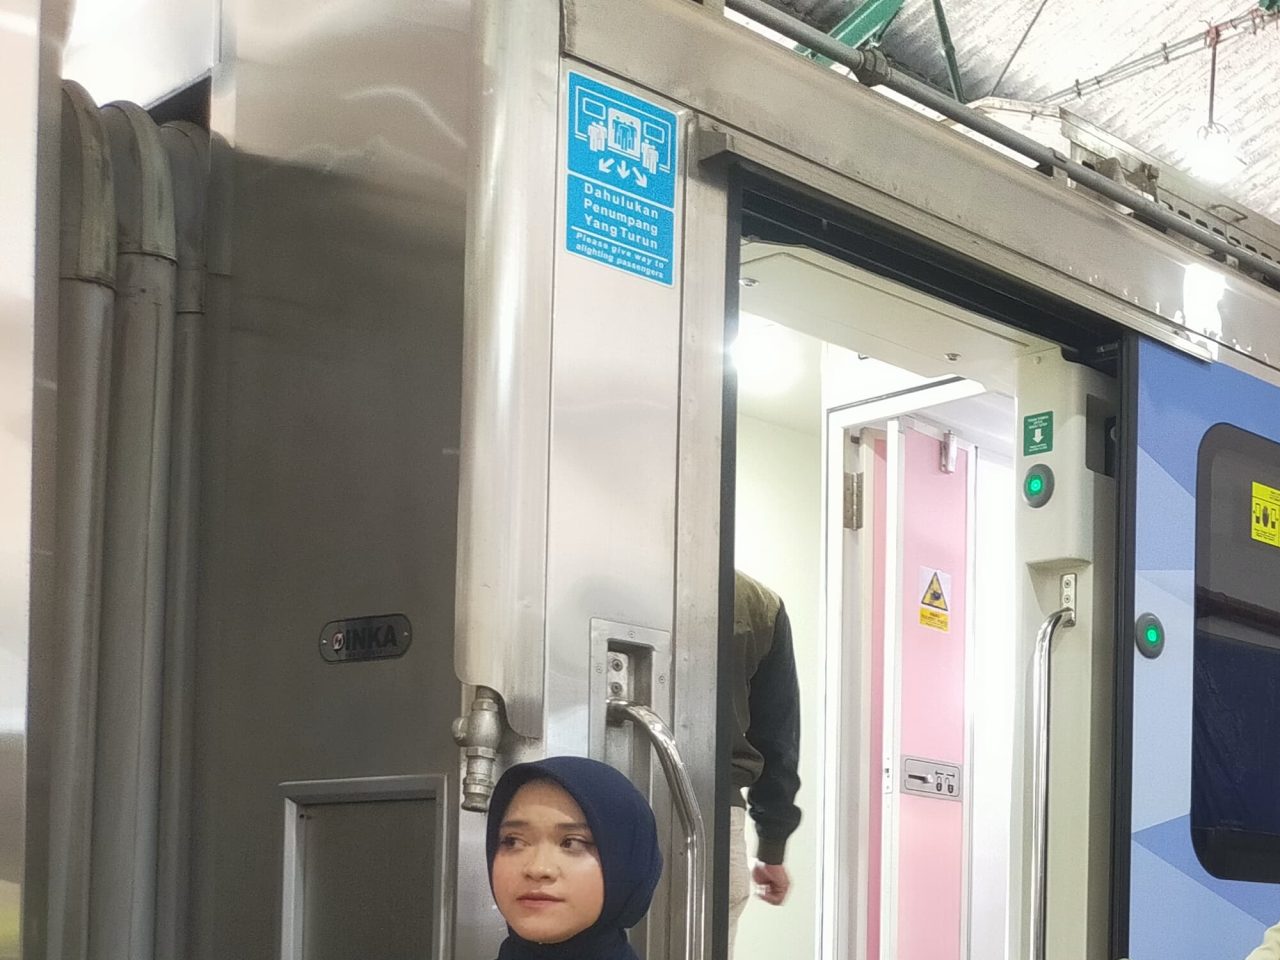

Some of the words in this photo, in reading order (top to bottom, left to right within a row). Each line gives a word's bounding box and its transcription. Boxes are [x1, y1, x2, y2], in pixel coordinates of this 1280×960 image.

[583, 198, 658, 236] Penumpang
[584, 182, 658, 219] Dahulukan
[584, 213, 617, 237] Yang
[620, 226, 658, 249] Turun
[576, 232, 608, 249] Please
[611, 243, 631, 257] give
[634, 252, 653, 265] way
[655, 260, 664, 269] to
[576, 243, 614, 262] alighting
[616, 258, 664, 278] passengers
[346, 624, 398, 651] INKA
